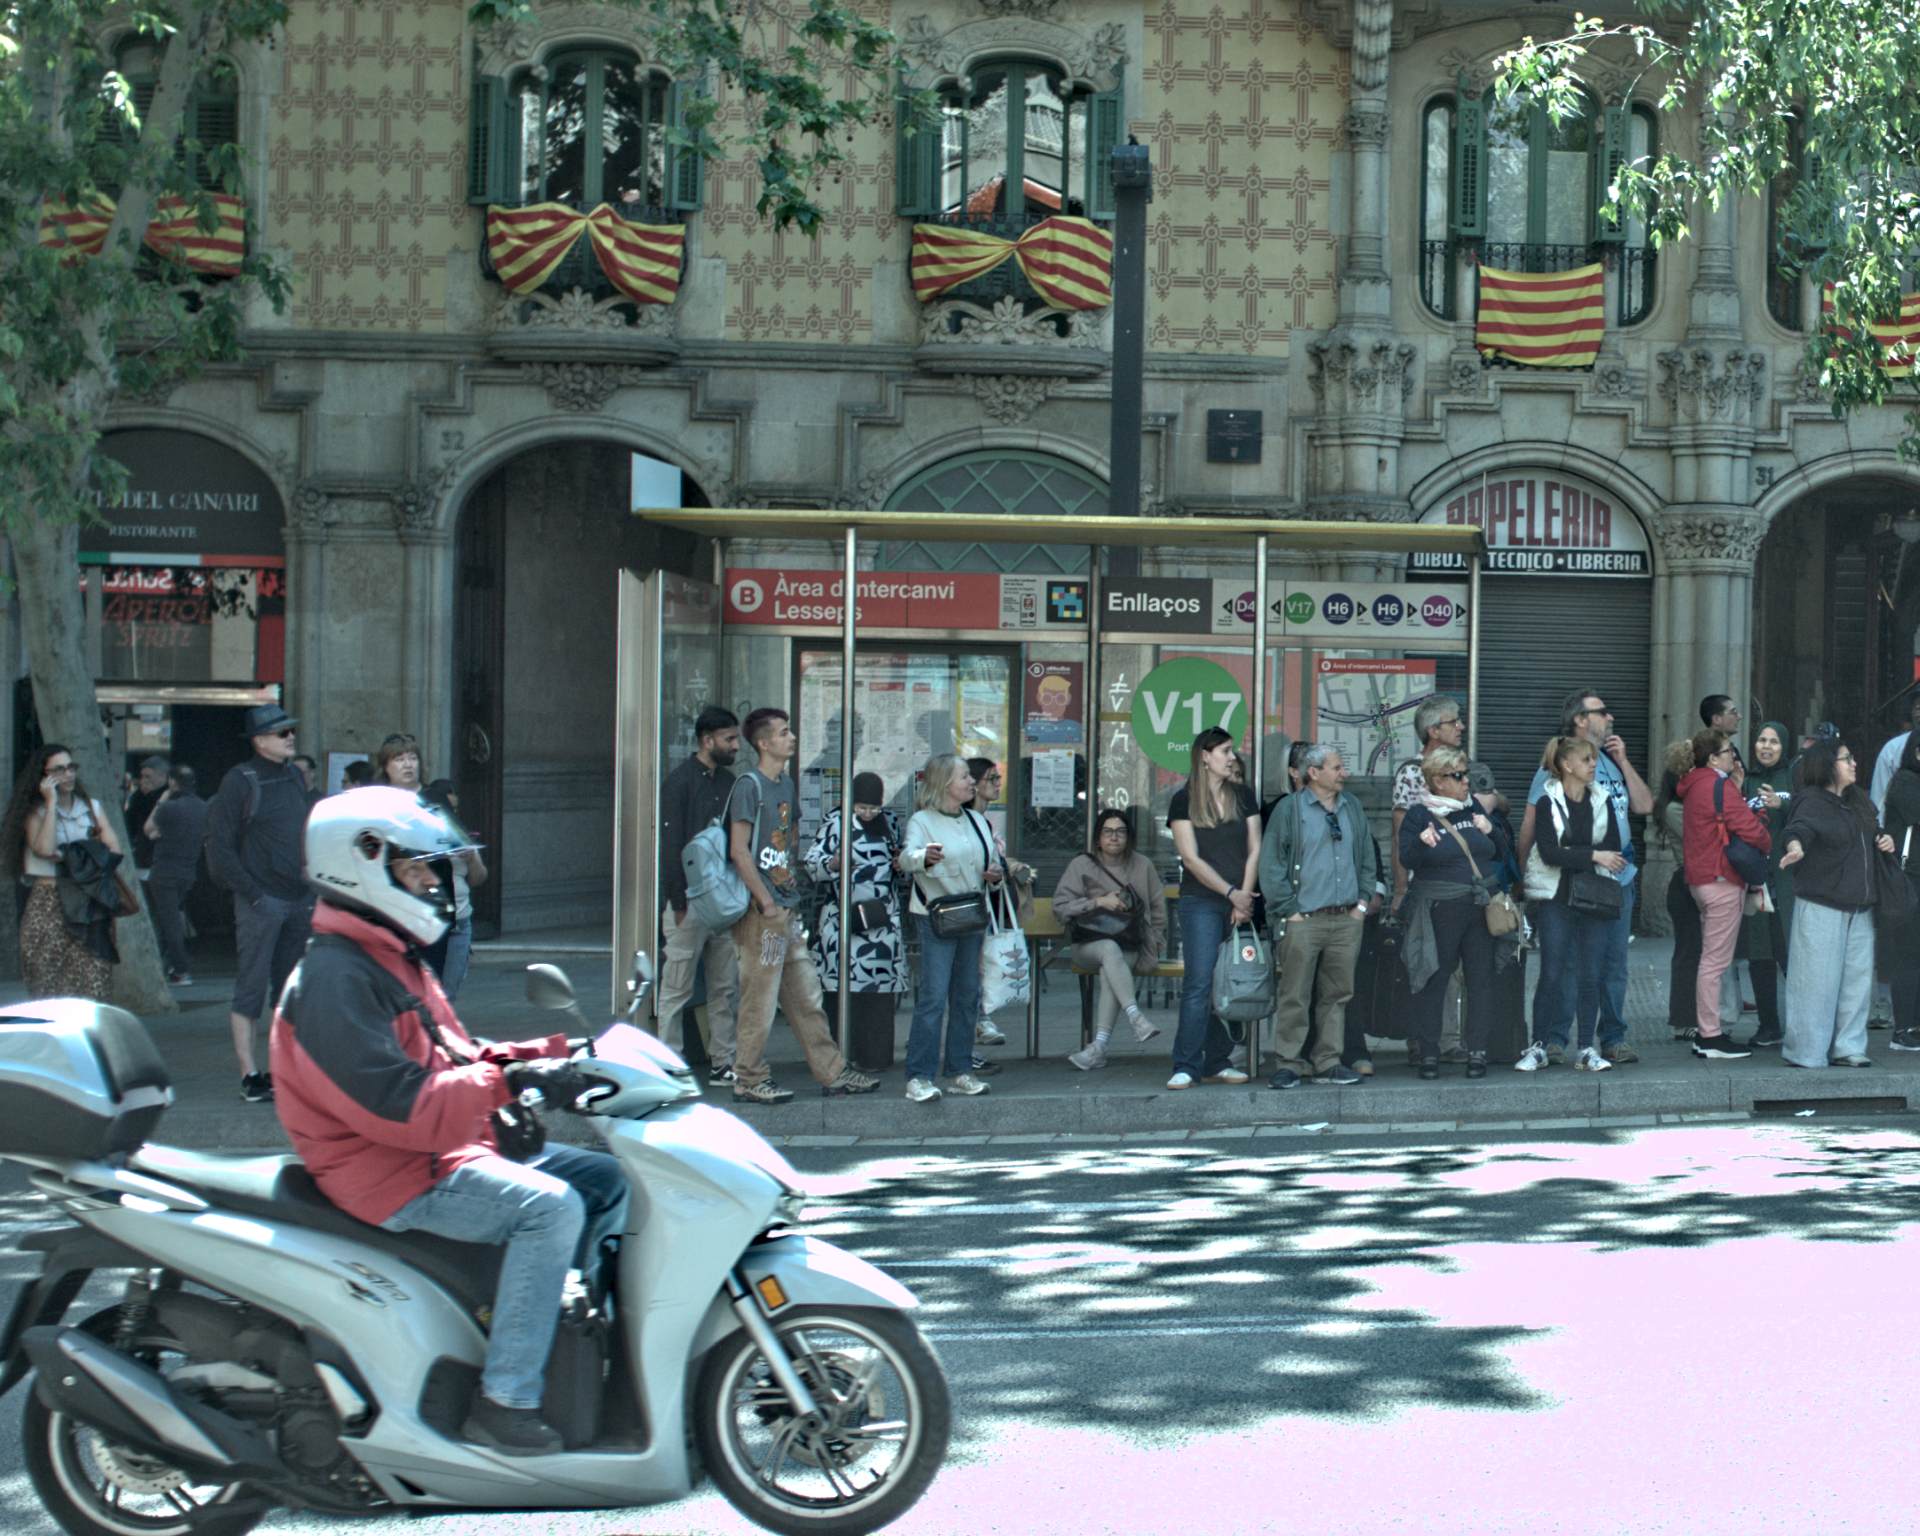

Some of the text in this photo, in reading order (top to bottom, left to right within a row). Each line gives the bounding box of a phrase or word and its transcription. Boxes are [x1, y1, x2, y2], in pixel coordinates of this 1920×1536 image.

[123, 490, 163, 509] DEL
[169, 491, 259, 511] CANARI
[109, 524, 198, 539] RISTORANTE
[1413, 551, 1642, 571] DIBUJ TECNICO LIBRERIA
[774, 572, 955, 599] Àrea dntercanvi
[1108, 592, 1200, 617] Enllaços
[1236, 599, 1256, 613] D4
[1286, 601, 1312, 613] V17
[1327, 602, 1349, 615] H6
[1377, 603, 1399, 616] H6
[1423, 604, 1452, 617] D40
[1142, 691, 1241, 735] V17
[1167, 742, 1189, 751] Port
